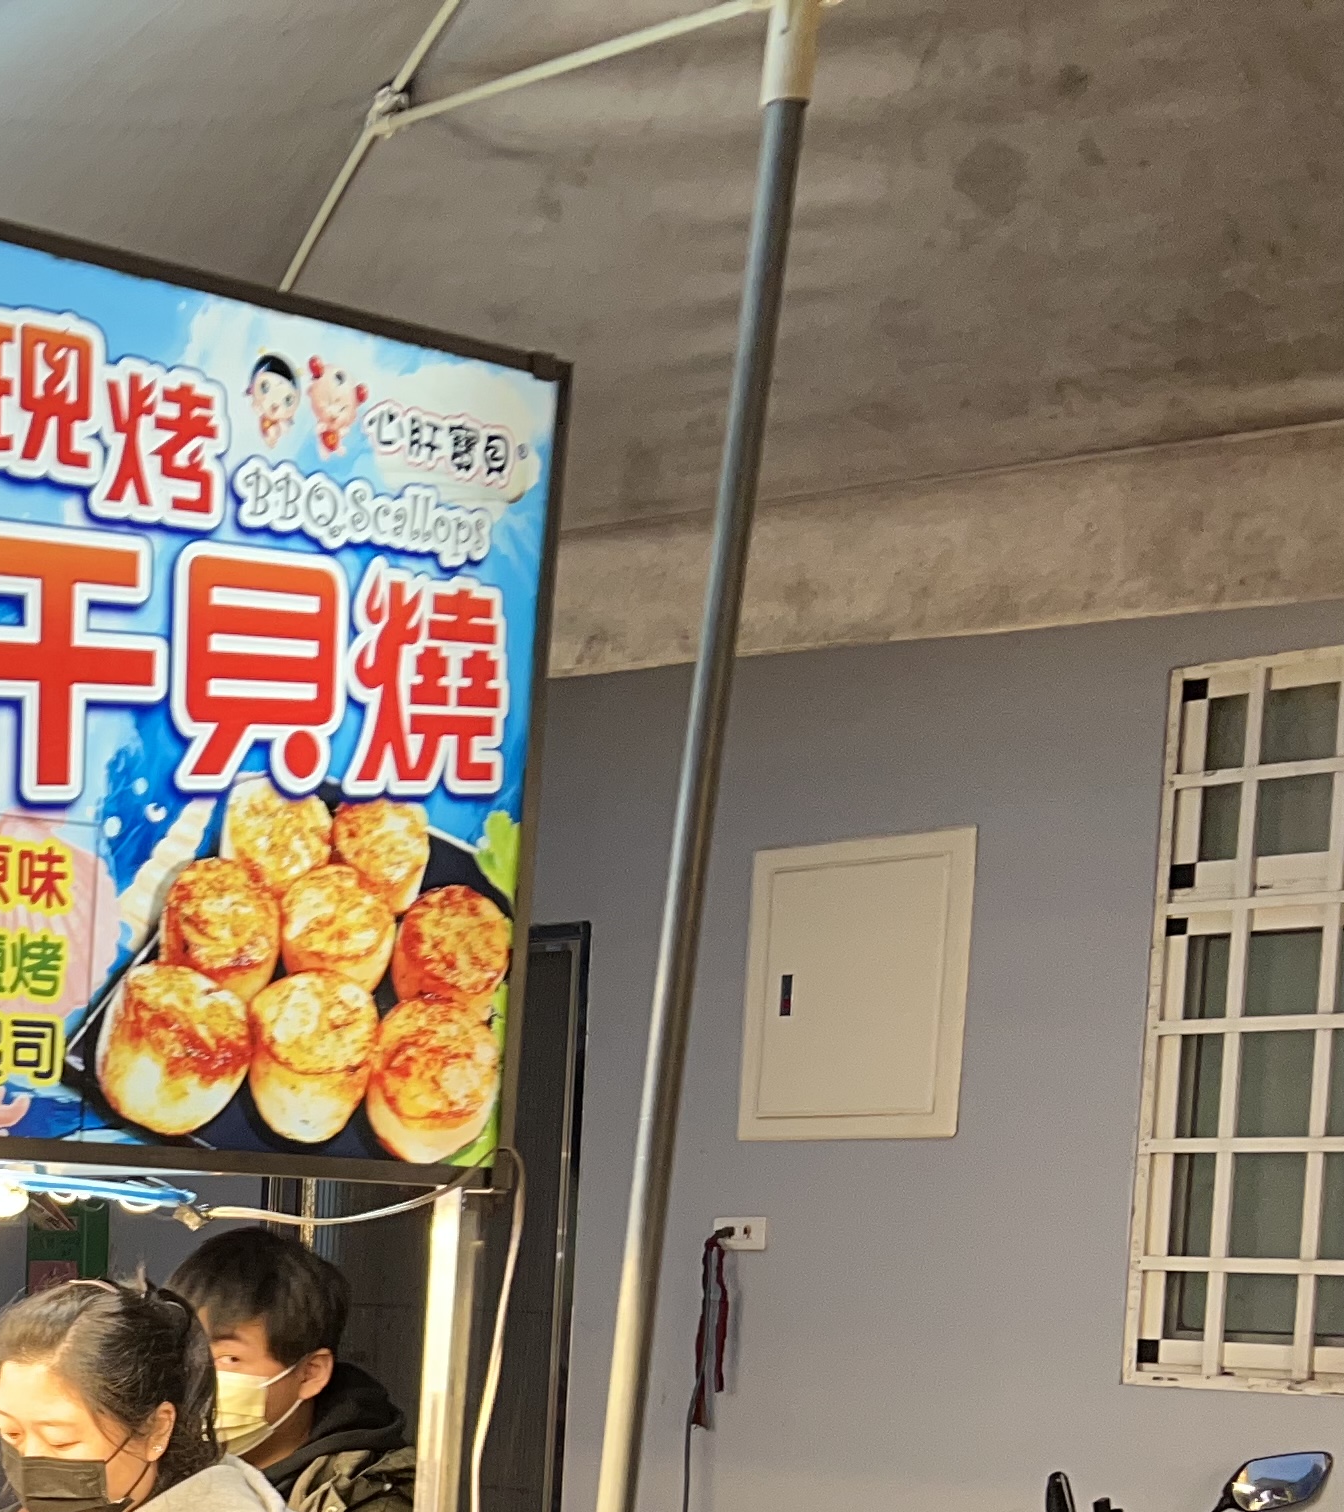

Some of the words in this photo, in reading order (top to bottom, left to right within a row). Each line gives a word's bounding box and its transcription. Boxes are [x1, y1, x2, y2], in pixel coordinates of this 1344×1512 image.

[367, 405, 509, 476] 心肝寶貝
[244, 466, 344, 538] BBQ
[350, 487, 488, 558] Scallops
